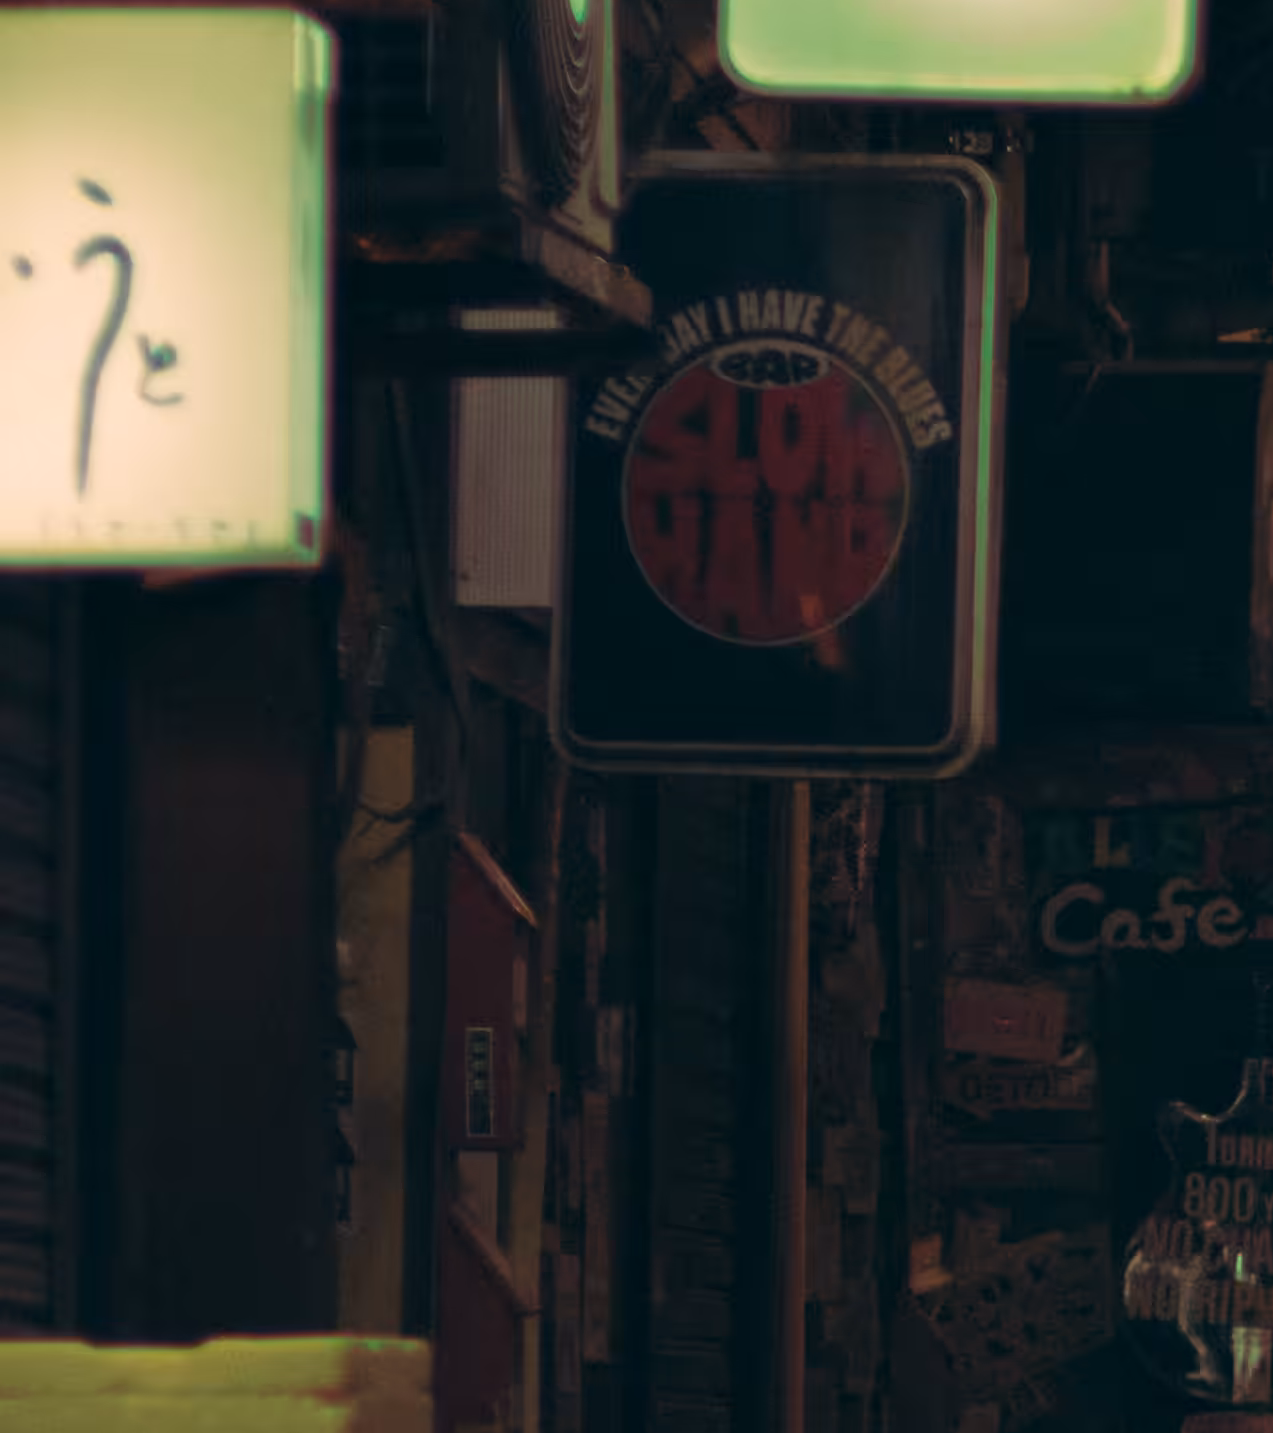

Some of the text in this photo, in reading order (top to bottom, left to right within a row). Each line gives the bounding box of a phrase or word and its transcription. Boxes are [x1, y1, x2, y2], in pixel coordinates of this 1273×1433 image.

[737, 286, 827, 336] HAVE
[829, 299, 896, 368] THE
[872, 342, 955, 450] BLUES
[1041, 875, 1250, 957] Cafe
